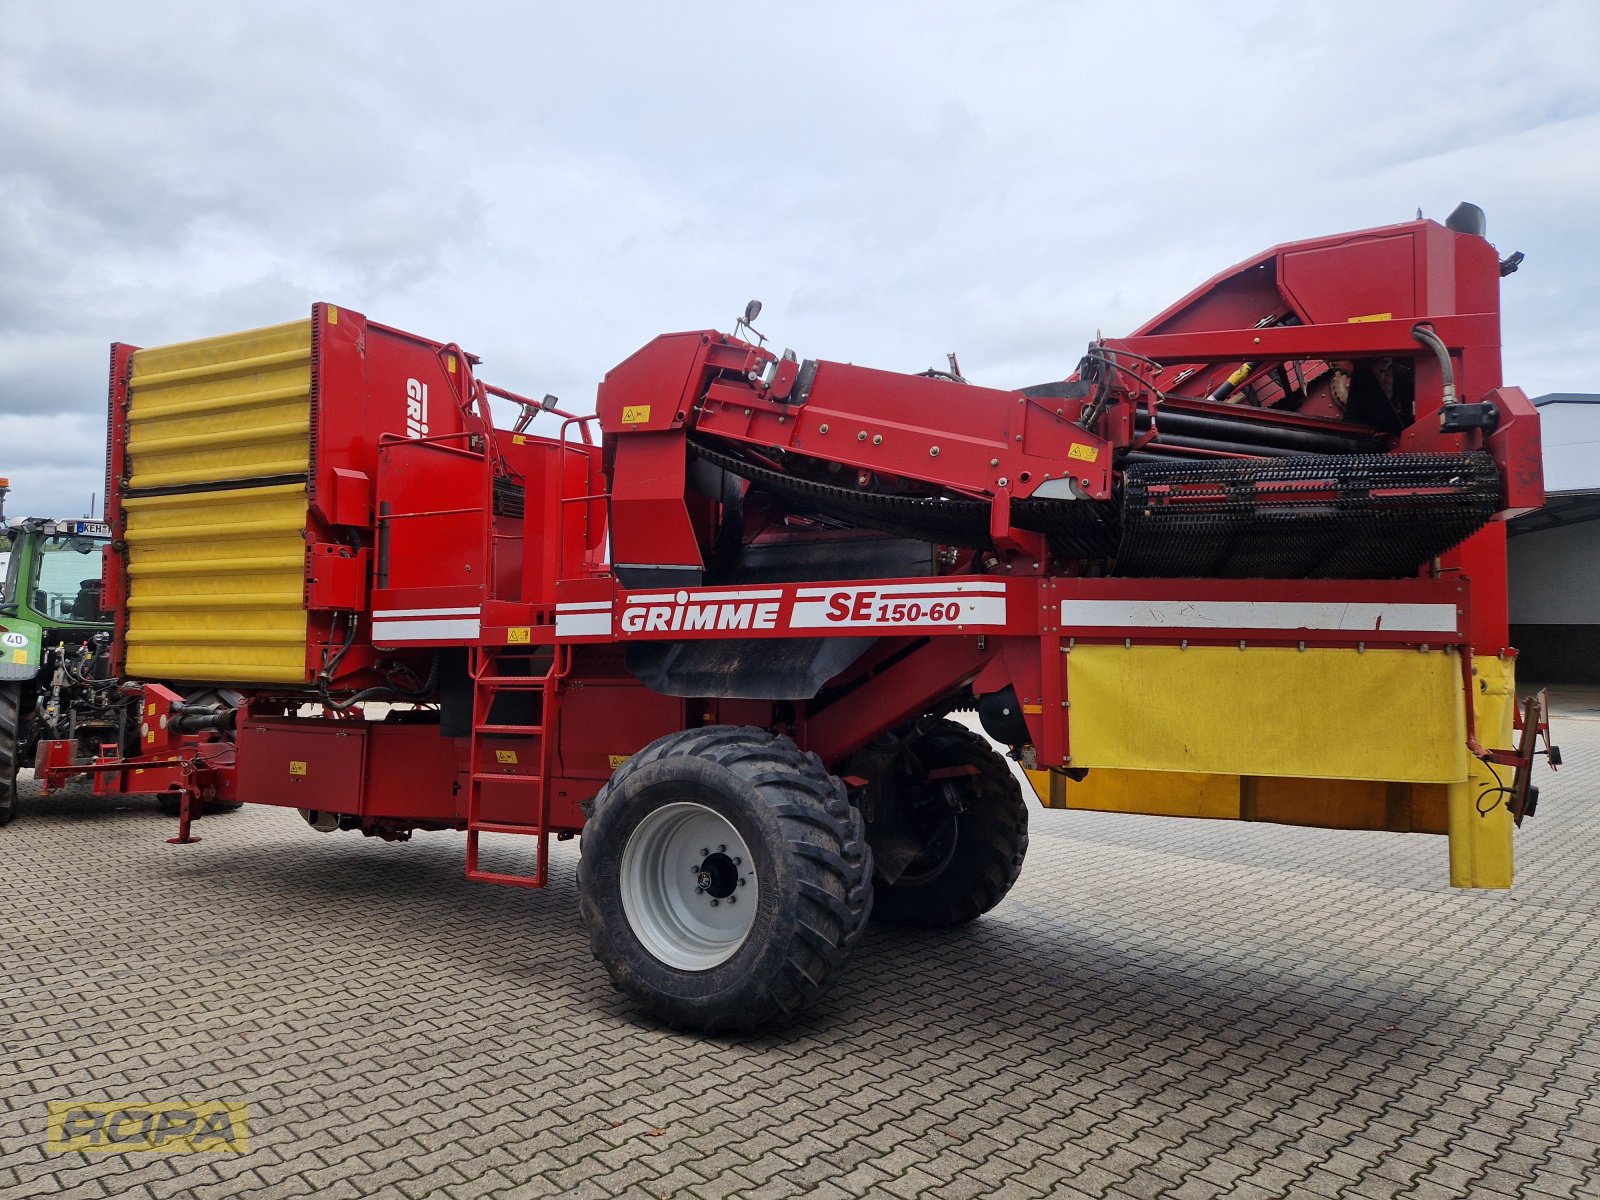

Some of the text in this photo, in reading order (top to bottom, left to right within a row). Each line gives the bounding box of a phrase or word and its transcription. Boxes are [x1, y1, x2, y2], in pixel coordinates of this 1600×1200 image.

[621, 590, 783, 632] GRIMME
[825, 591, 961, 623] SE 150-60
[6, 635, 23, 644] 40
